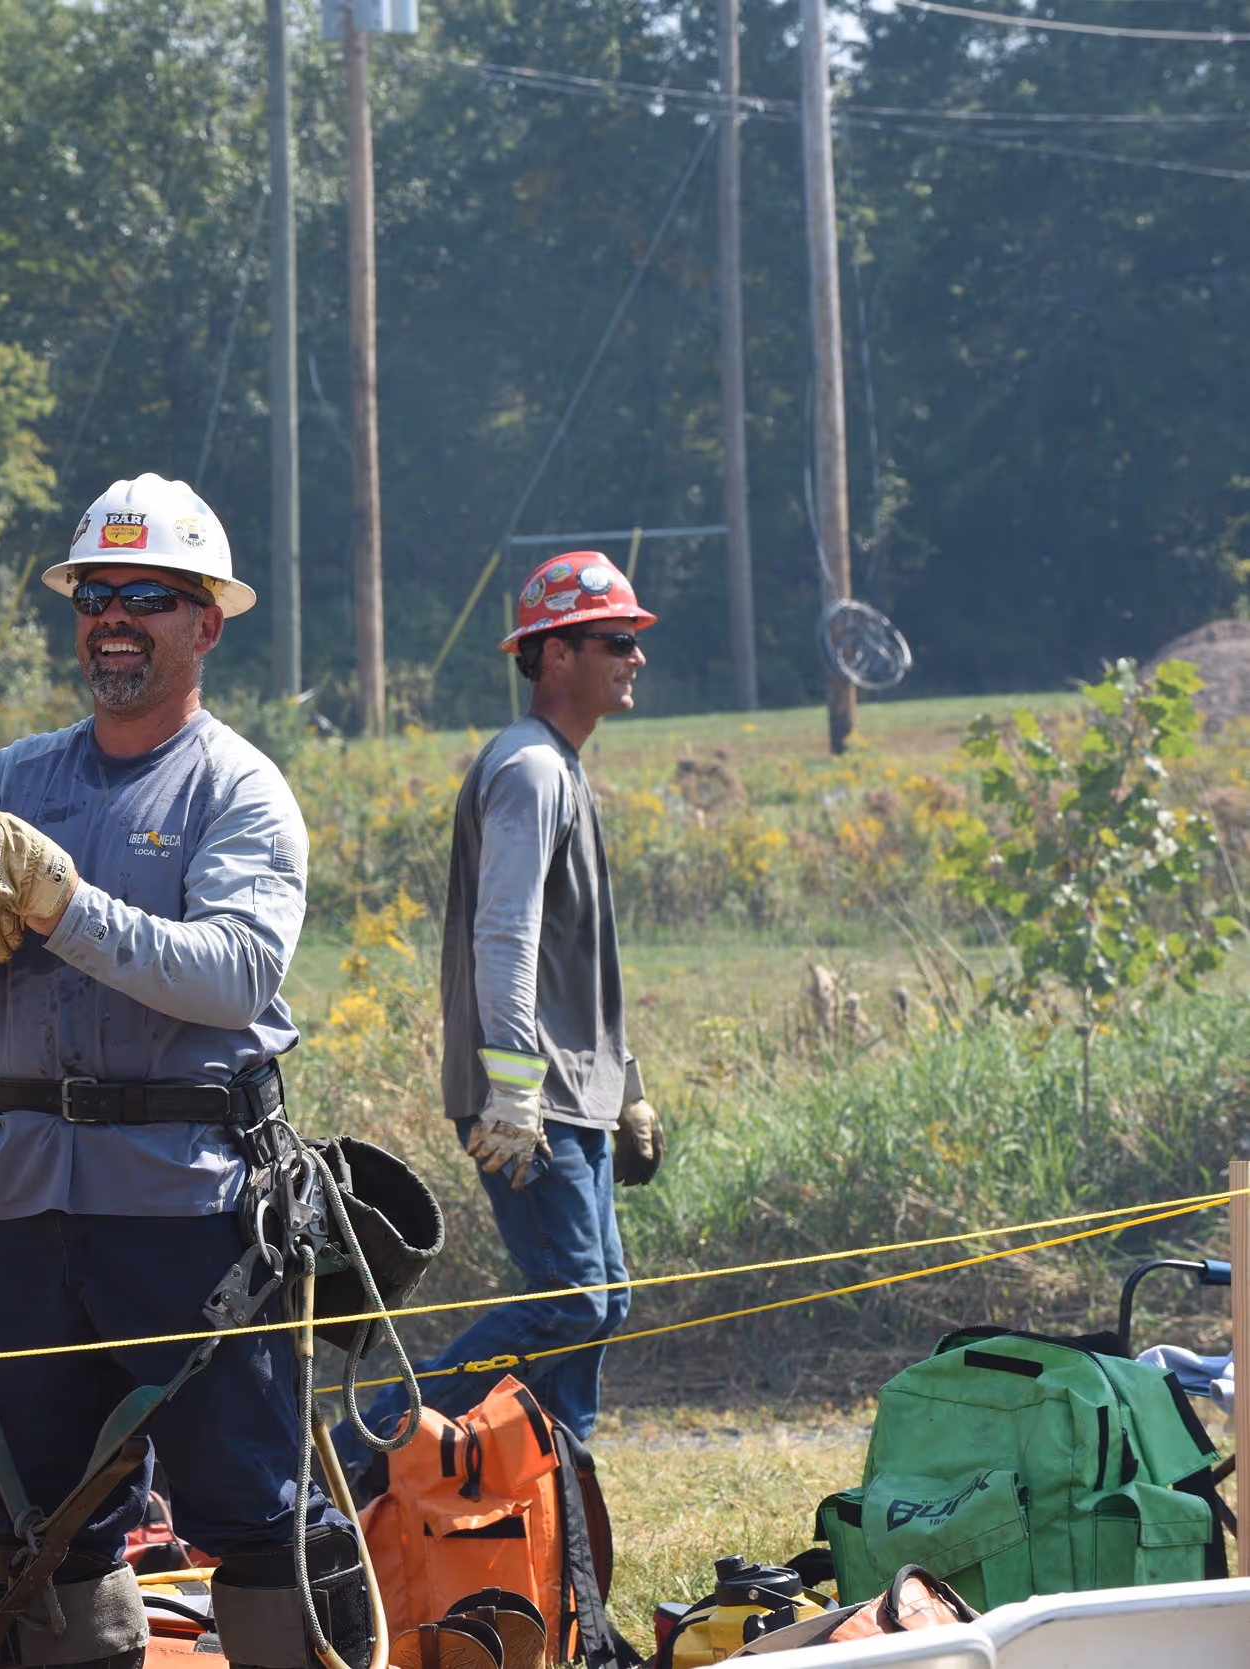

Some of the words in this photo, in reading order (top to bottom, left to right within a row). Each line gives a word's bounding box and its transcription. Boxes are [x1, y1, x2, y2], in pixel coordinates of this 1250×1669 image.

[108, 515, 142, 525] PAR
[129, 833, 149, 844] IBEW
[158, 834, 181, 846] NECA
[134, 849, 156, 857] LOCAL
